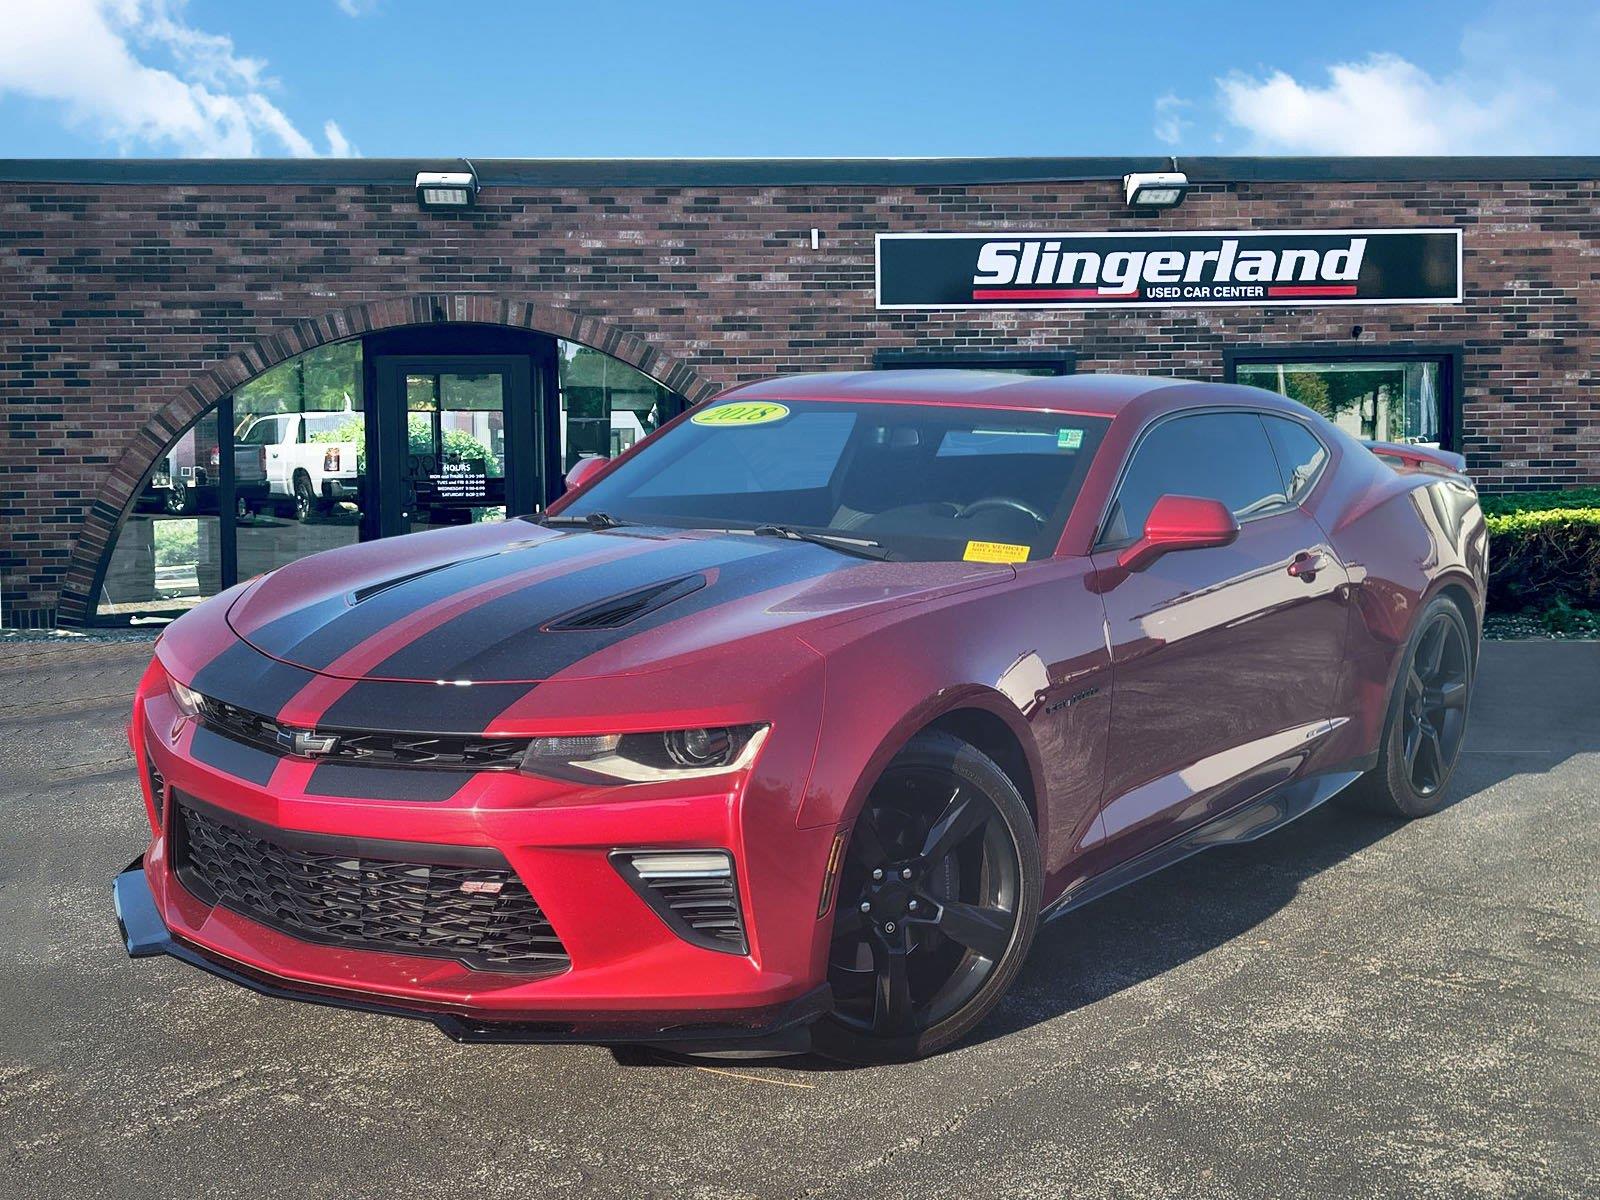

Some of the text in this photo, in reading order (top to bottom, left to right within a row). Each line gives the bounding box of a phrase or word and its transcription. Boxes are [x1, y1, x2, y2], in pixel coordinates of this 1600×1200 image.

[973, 238, 1368, 296] Slingerland
[1146, 286, 1264, 298] USED CAR CENTER
[700, 407, 779, 421] 2018
